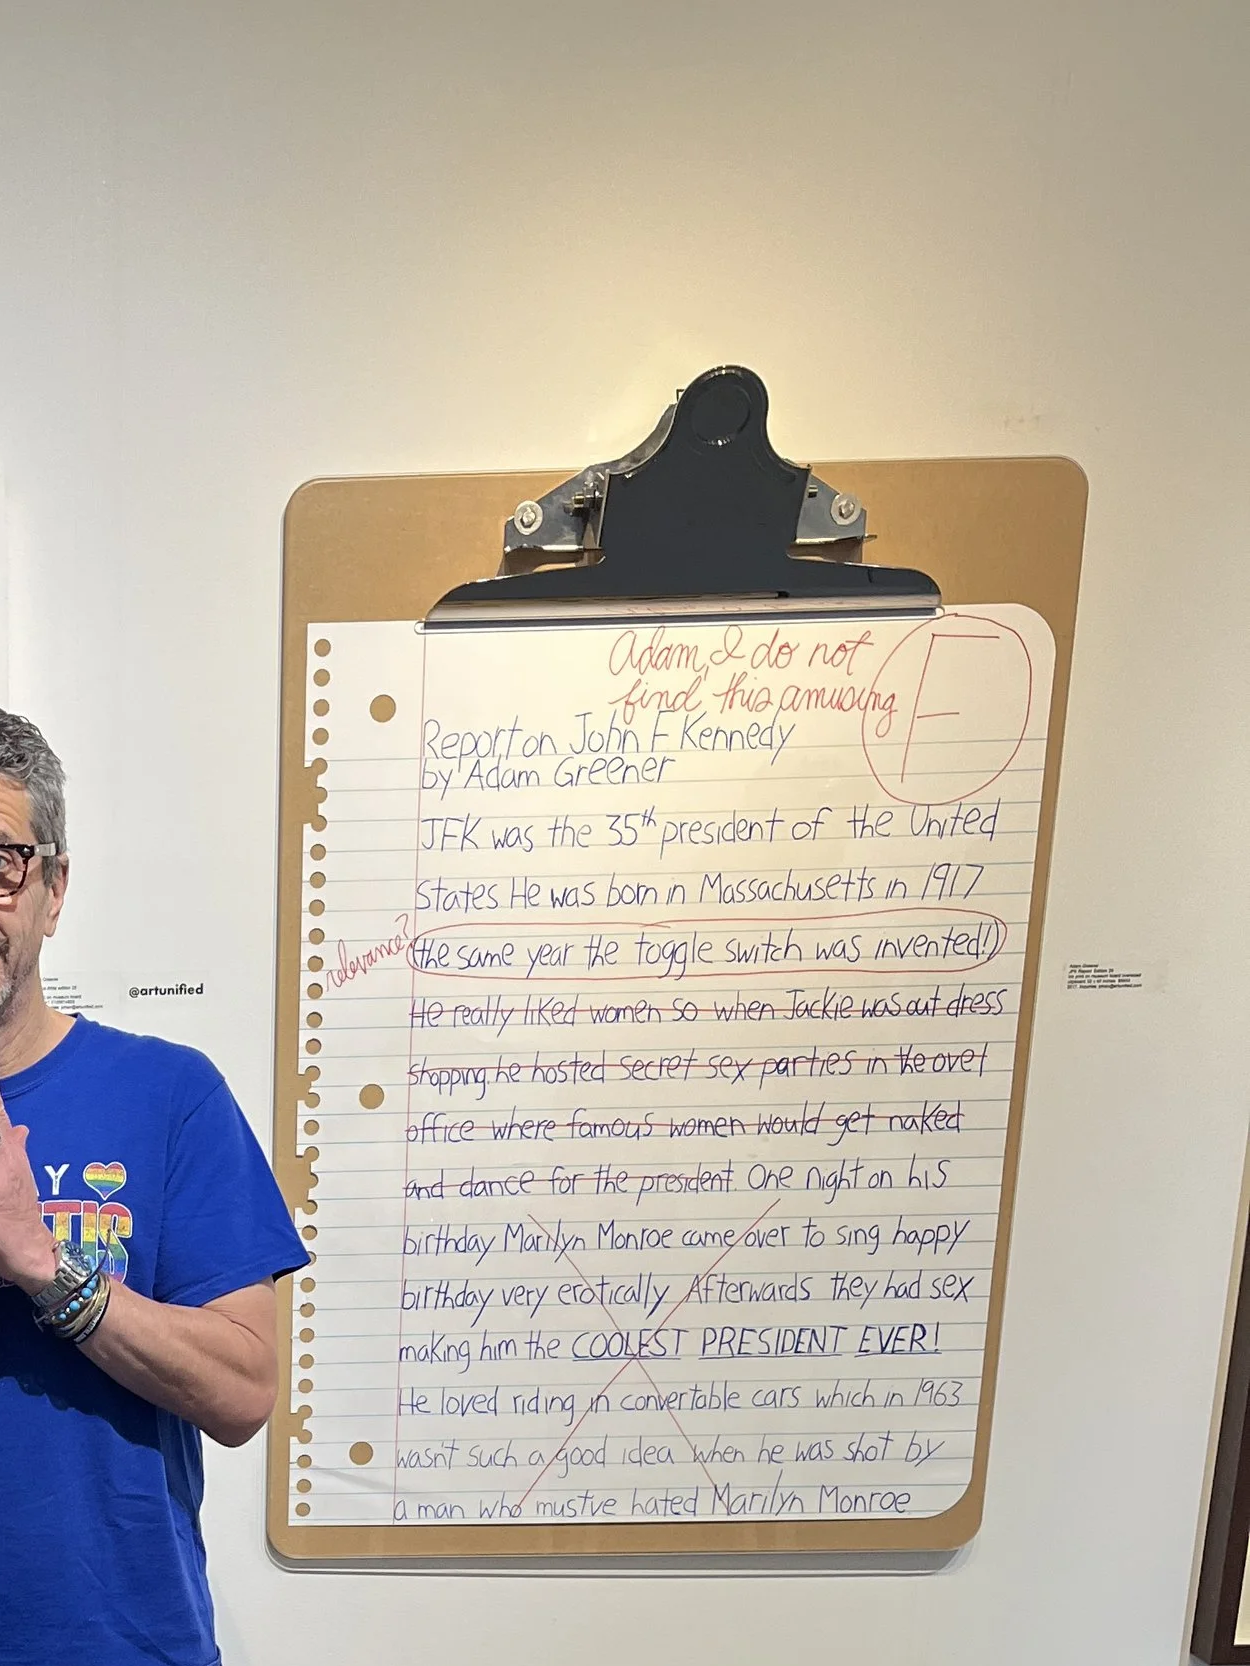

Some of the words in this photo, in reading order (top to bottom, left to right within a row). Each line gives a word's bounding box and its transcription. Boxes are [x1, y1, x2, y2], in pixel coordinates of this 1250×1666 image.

[609, 625, 709, 681] Adam,
[710, 624, 746, 665] I
[751, 629, 800, 670] do
[808, 630, 874, 676] not
[609, 667, 703, 724] find
[712, 671, 773, 715] this
[779, 684, 898, 738] amusing
[423, 716, 523, 773] Report
[523, 731, 557, 756] on
[570, 710, 639, 754] John
[651, 710, 674, 752] F
[680, 706, 796, 766] Kennedy
[421, 756, 454, 800] by
[464, 754, 540, 791] Adam
[554, 756, 675, 788] Greener
[421, 813, 481, 852] JFK
[492, 823, 533, 853] was
[547, 815, 592, 848] the
[660, 807, 784, 859] president
[791, 807, 833, 841] of
[847, 804, 894, 839] the
[910, 798, 1001, 842] United
[415, 876, 499, 913] States
[510, 876, 541, 909] He
[550, 881, 595, 908] was
[606, 872, 658, 907] born
[666, 878, 686, 905] in
[699, 866, 877, 904] Massachusetts
[885, 877, 907, 900] in
[921, 862, 985, 901] 1917
[326, 913, 409, 992] relevance?
[411, 936, 450, 969] (the
[458, 942, 515, 970] same
[527, 942, 575, 979] year
[584, 934, 619, 971] the
[634, 931, 713, 980] toggle
[725, 928, 802, 965] switch
[816, 934, 862, 963] was
[874, 919, 1000, 961] invented!)
[129, 983, 204, 999] @artunified
[747, 1163, 794, 1190] One
[806, 1157, 864, 1205] night
[868, 1172, 893, 1188] on
[909, 1153, 951, 1188] his
[403, 1224, 496, 1267] birthday
[503, 1218, 586, 1263] Marilyn
[598, 1219, 673, 1250] Monroe
[681, 1227, 735, 1248] came
[744, 1224, 790, 1249] over
[802, 1216, 825, 1249] to
[836, 1224, 879, 1255] sing
[892, 1214, 971, 1256] happy
[402, 1278, 494, 1328] birthday
[501, 1285, 549, 1319] very
[557, 1271, 670, 1320] erotically
[685, 1272, 813, 1304] Afterwards
[830, 1271, 878, 1310] they
[884, 1269, 923, 1300] had
[929, 1274, 975, 1302] sex
[400, 1330, 471, 1375] making
[479, 1329, 517, 1362] him
[524, 1329, 561, 1360] the
[572, 1328, 689, 1360] COOLEST
[700, 1324, 849, 1356] PRESIDENT
[858, 1321, 941, 1354] EVER!
[399, 1386, 431, 1416] He
[441, 1385, 499, 1418] loved
[512, 1386, 575, 1427] riding
[590, 1392, 610, 1413] in
[620, 1379, 740, 1412] convertable
[751, 1385, 802, 1408] cars
[815, 1379, 875, 1409] which
[883, 1385, 903, 1407] in
[913, 1378, 963, 1407] 1963
[466, 1440, 518, 1468] such
[528, 1450, 545, 1465] a
[555, 1434, 608, 1479] good
[622, 1435, 674, 1465] idea
[693, 1434, 745, 1464] when
[757, 1434, 784, 1464] he
[795, 1440, 834, 1461] was
[842, 1430, 894, 1463] shot
[905, 1430, 945, 1468] by
[393, 1499, 408, 1521] a
[417, 1502, 464, 1519] man
[479, 1490, 522, 1519] who
[536, 1489, 617, 1518] mustve
[630, 1485, 699, 1517] hated
[711, 1469, 804, 1517] Marilyn
[819, 1485, 911, 1514] Monroe
